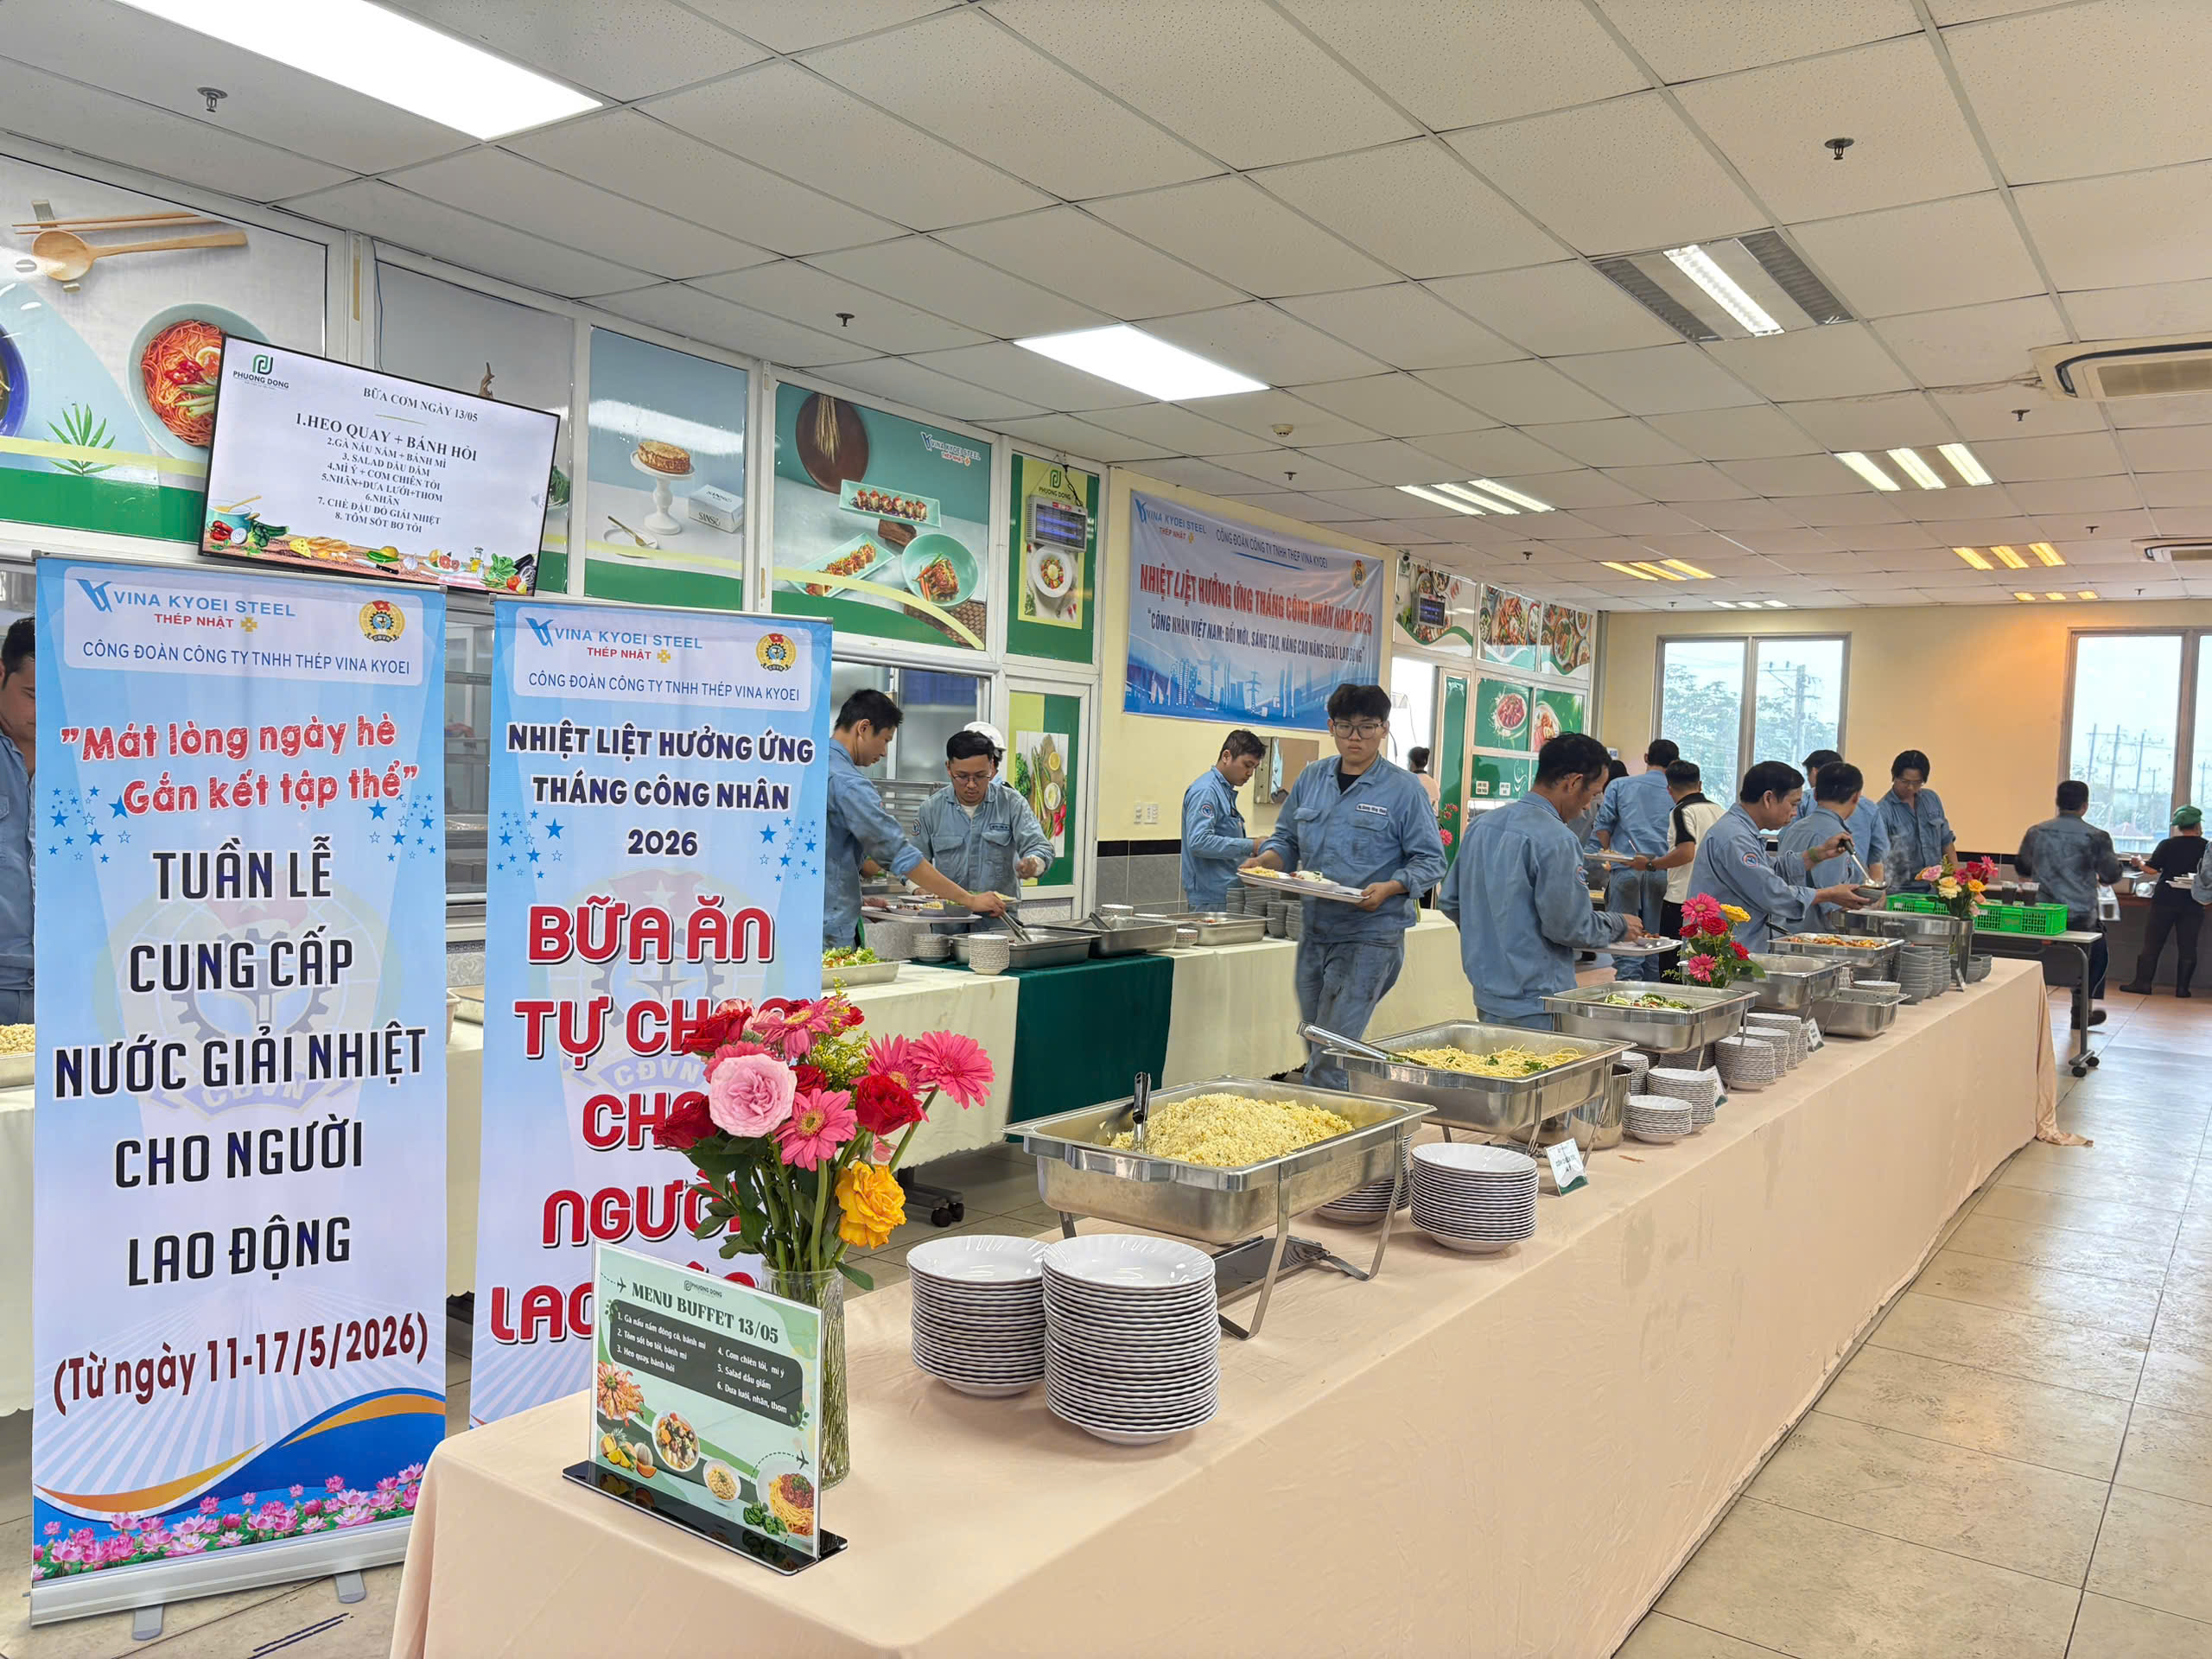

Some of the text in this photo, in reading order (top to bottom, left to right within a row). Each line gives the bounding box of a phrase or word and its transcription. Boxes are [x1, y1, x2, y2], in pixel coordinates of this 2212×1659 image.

[233, 371, 265, 384] PHUONG
[267, 378, 289, 388] DONG
[364, 387, 478, 422] BỮA CƠM NGÀY 13/05
[296, 413, 342, 433] 1.HEO
[346, 423, 391, 443] QUAY
[407, 435, 447, 455] BÁNH
[352, 454, 385, 467] SALAD
[1146, 509, 1206, 534] VINA KYOEI STEEL
[113, 590, 296, 618] VINA KYOEI STEEL
[1141, 563, 1173, 601] NHIỆT
[1173, 569, 1197, 607] LIỆT
[1198, 572, 1231, 609] HƯỞNG
[1234, 581, 1253, 613] ỨNG
[1255, 588, 1284, 620] THÁNG
[1286, 594, 1310, 625] CÔNG
[1311, 601, 1334, 629] NHÂN
[1354, 612, 1373, 636] 2026
[154, 613, 233, 630] THÉP NHẬT
[555, 627, 703, 650] VINA KYOEI STEEL
[83, 639, 410, 676] CÔNG ĐOÀN CÔNG TY TNHH THÉP VINA KYOEI
[587, 646, 652, 661] THÉP NHẬT
[528, 671, 799, 702] CÔNG ĐOÀN CÔNG TY TNHH THÉP VINA KYOEI
[168, 721, 248, 760] lòng
[258, 715, 346, 756] ngày
[357, 712, 397, 747] hè
[508, 720, 814, 763] NHIỆT LIỆT HƯỞNG ỨNG
[123, 771, 197, 814] Gắn
[208, 766, 269, 810] kết
[280, 768, 339, 810] tập
[532, 769, 789, 809] THÁNG CÔNG NHÂN
[627, 829, 698, 856] 2026
[152, 836, 332, 899] TUẦN LỄ
[528, 895, 772, 962] BỮA ĂN
[130, 925, 353, 993] CUNG CẤP
[513, 996, 611, 1066] TỰ
[55, 1020, 426, 1098] NƯỚC GIẢI NHIỆT
[582, 1091, 706, 1147] CH
[115, 1114, 362, 1189] CHO NGƯỜI
[543, 1169, 741, 1246] NGƯ
[128, 1214, 350, 1286] LAO ĐỘNG
[618, 1312, 622, 1320] 1.
[624, 1314, 632, 1324] Gà
[632, 1282, 779, 1344] MENU BUFFET 13/05
[617, 1328, 622, 1337] 2.
[617, 1344, 622, 1353] 3.
[624, 1347, 634, 1357] Heo
[717, 1347, 723, 1356] 4.
[54, 1311, 428, 1415] (Từ ngày 11-17/5/2026)
[717, 1363, 723, 1373] 5.
[725, 1366, 741, 1380] Salad
[717, 1381, 722, 1390] 6.
